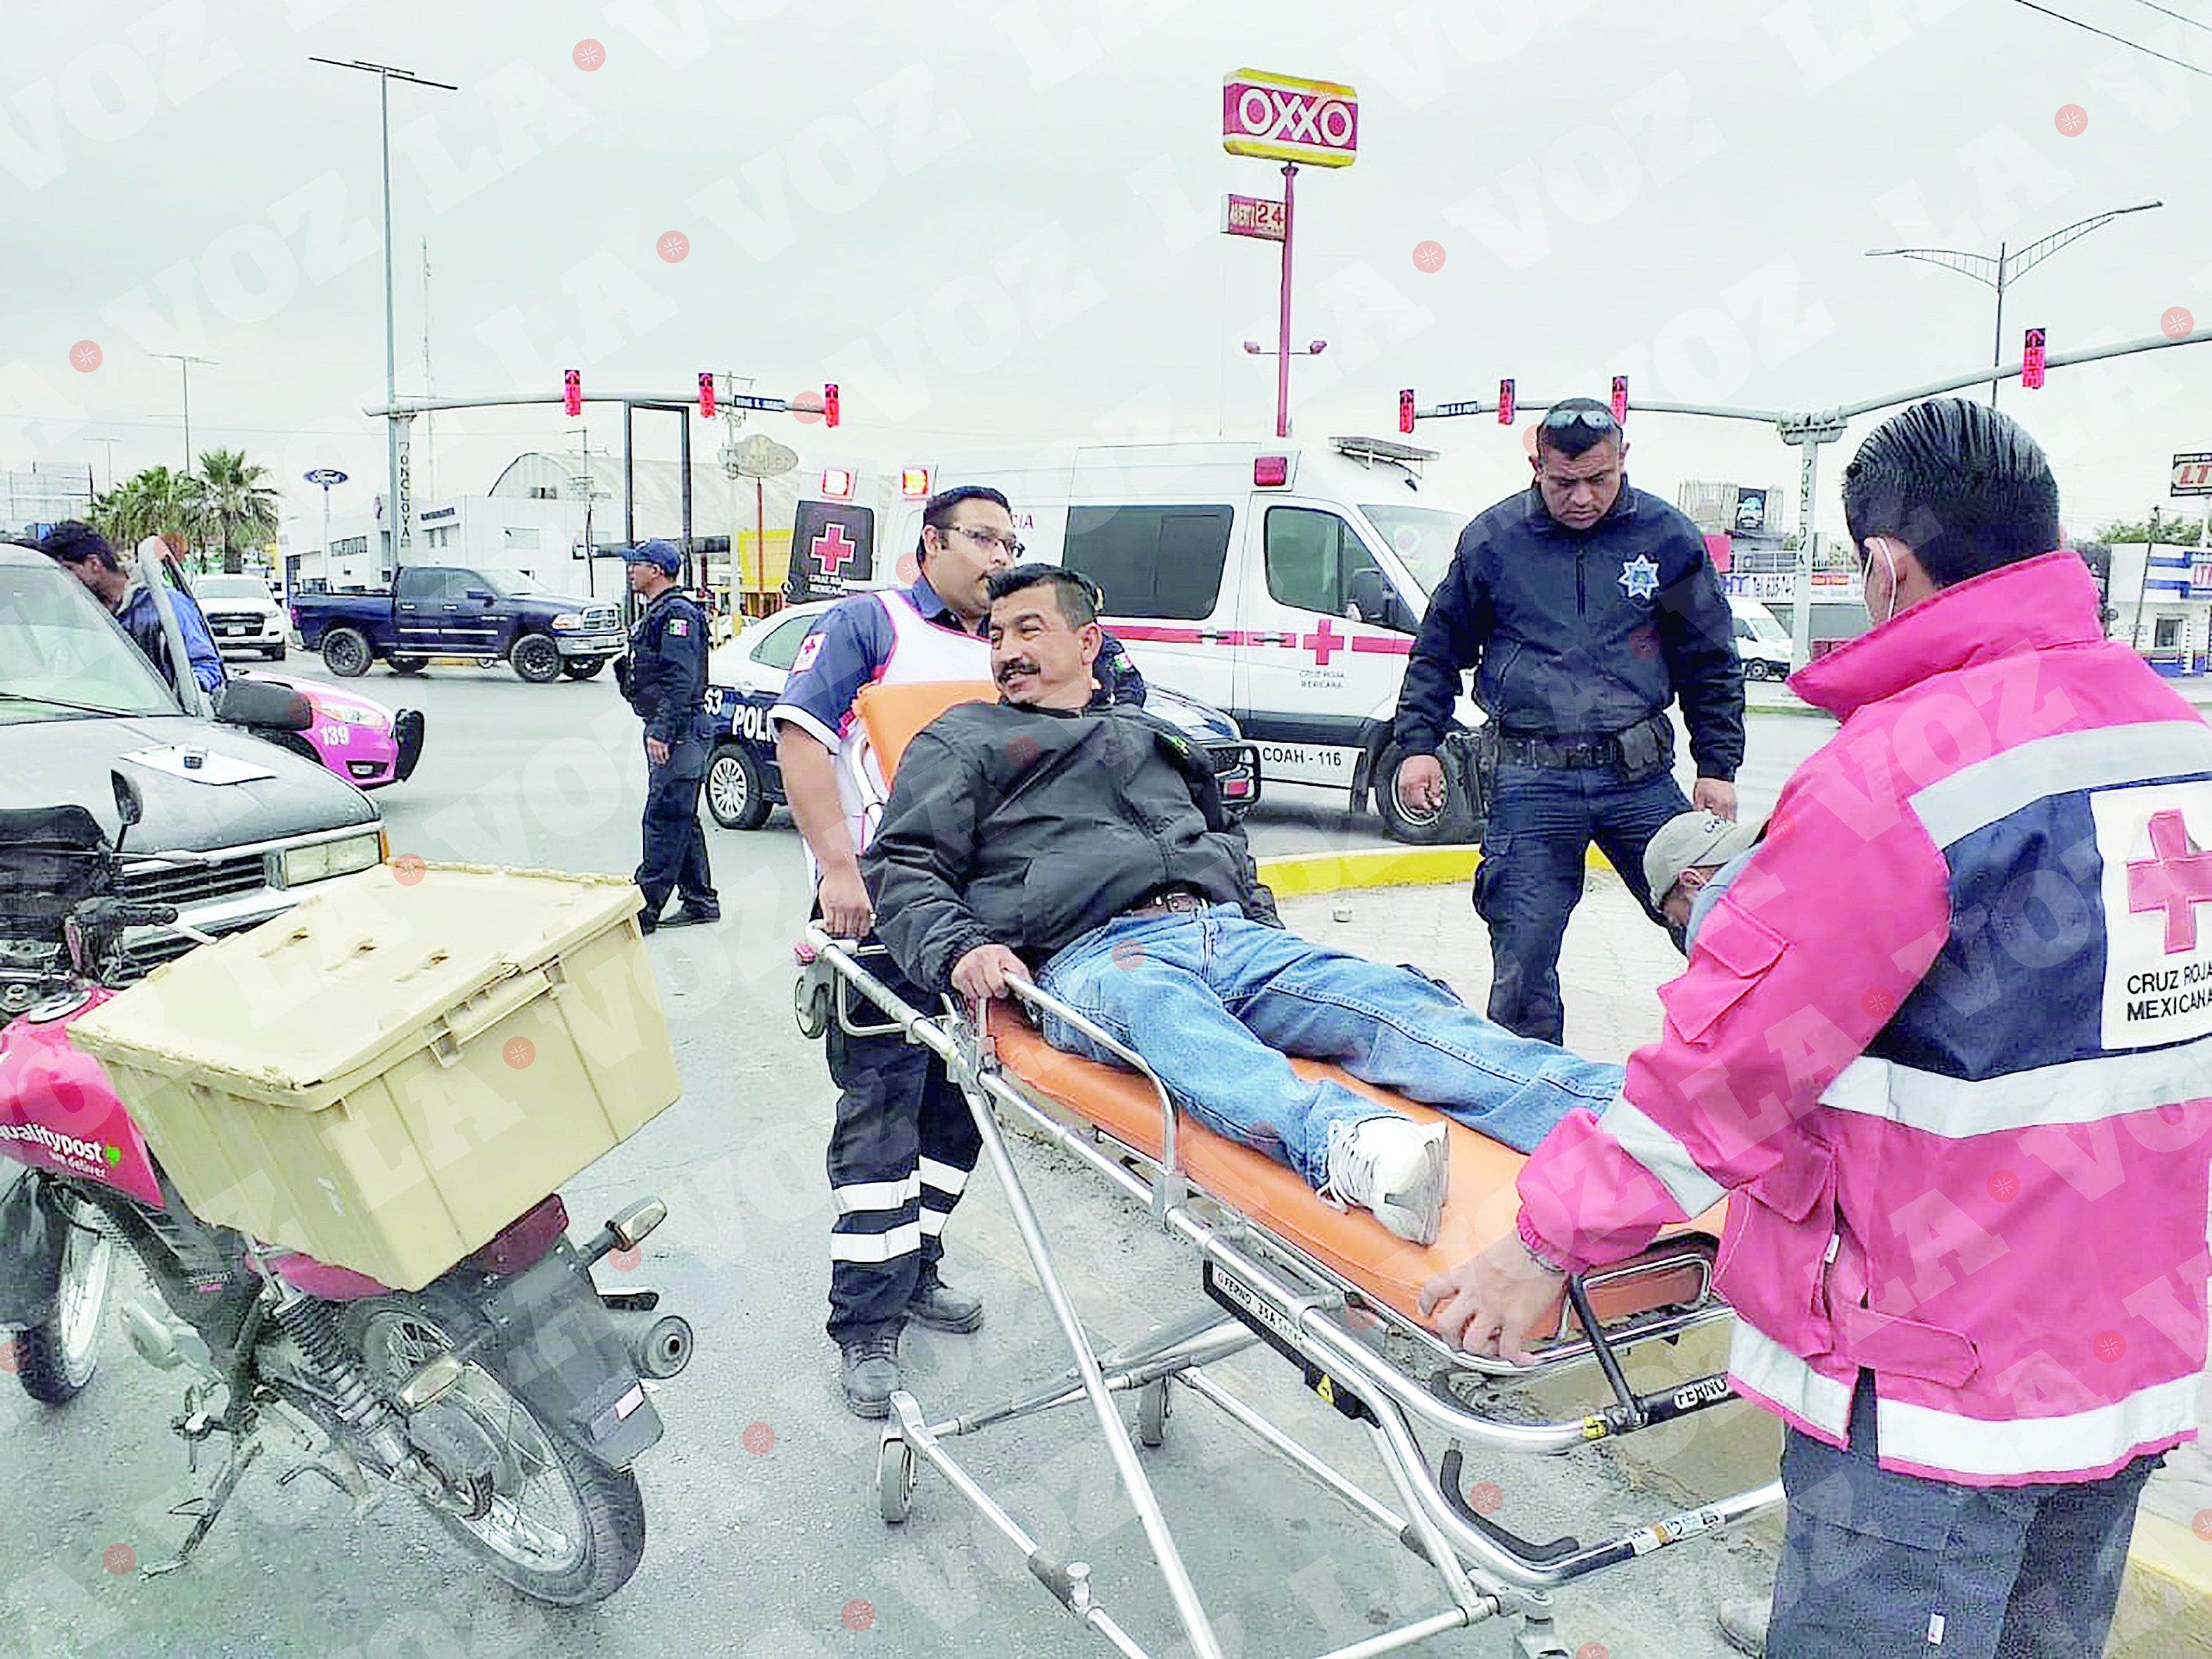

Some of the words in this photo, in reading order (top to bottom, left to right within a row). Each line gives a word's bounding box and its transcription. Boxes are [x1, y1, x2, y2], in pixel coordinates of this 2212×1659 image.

[1239, 87, 1353, 146] OXXO
[1258, 204, 1284, 226] 24
[1010, 514, 1034, 529] CIA
[732, 704, 772, 742] POLI
[319, 725, 350, 747] 139
[1262, 745, 1304, 765] COAH
[1318, 750, 1342, 766] 116
[2127, 969, 2179, 995] CRUZ
